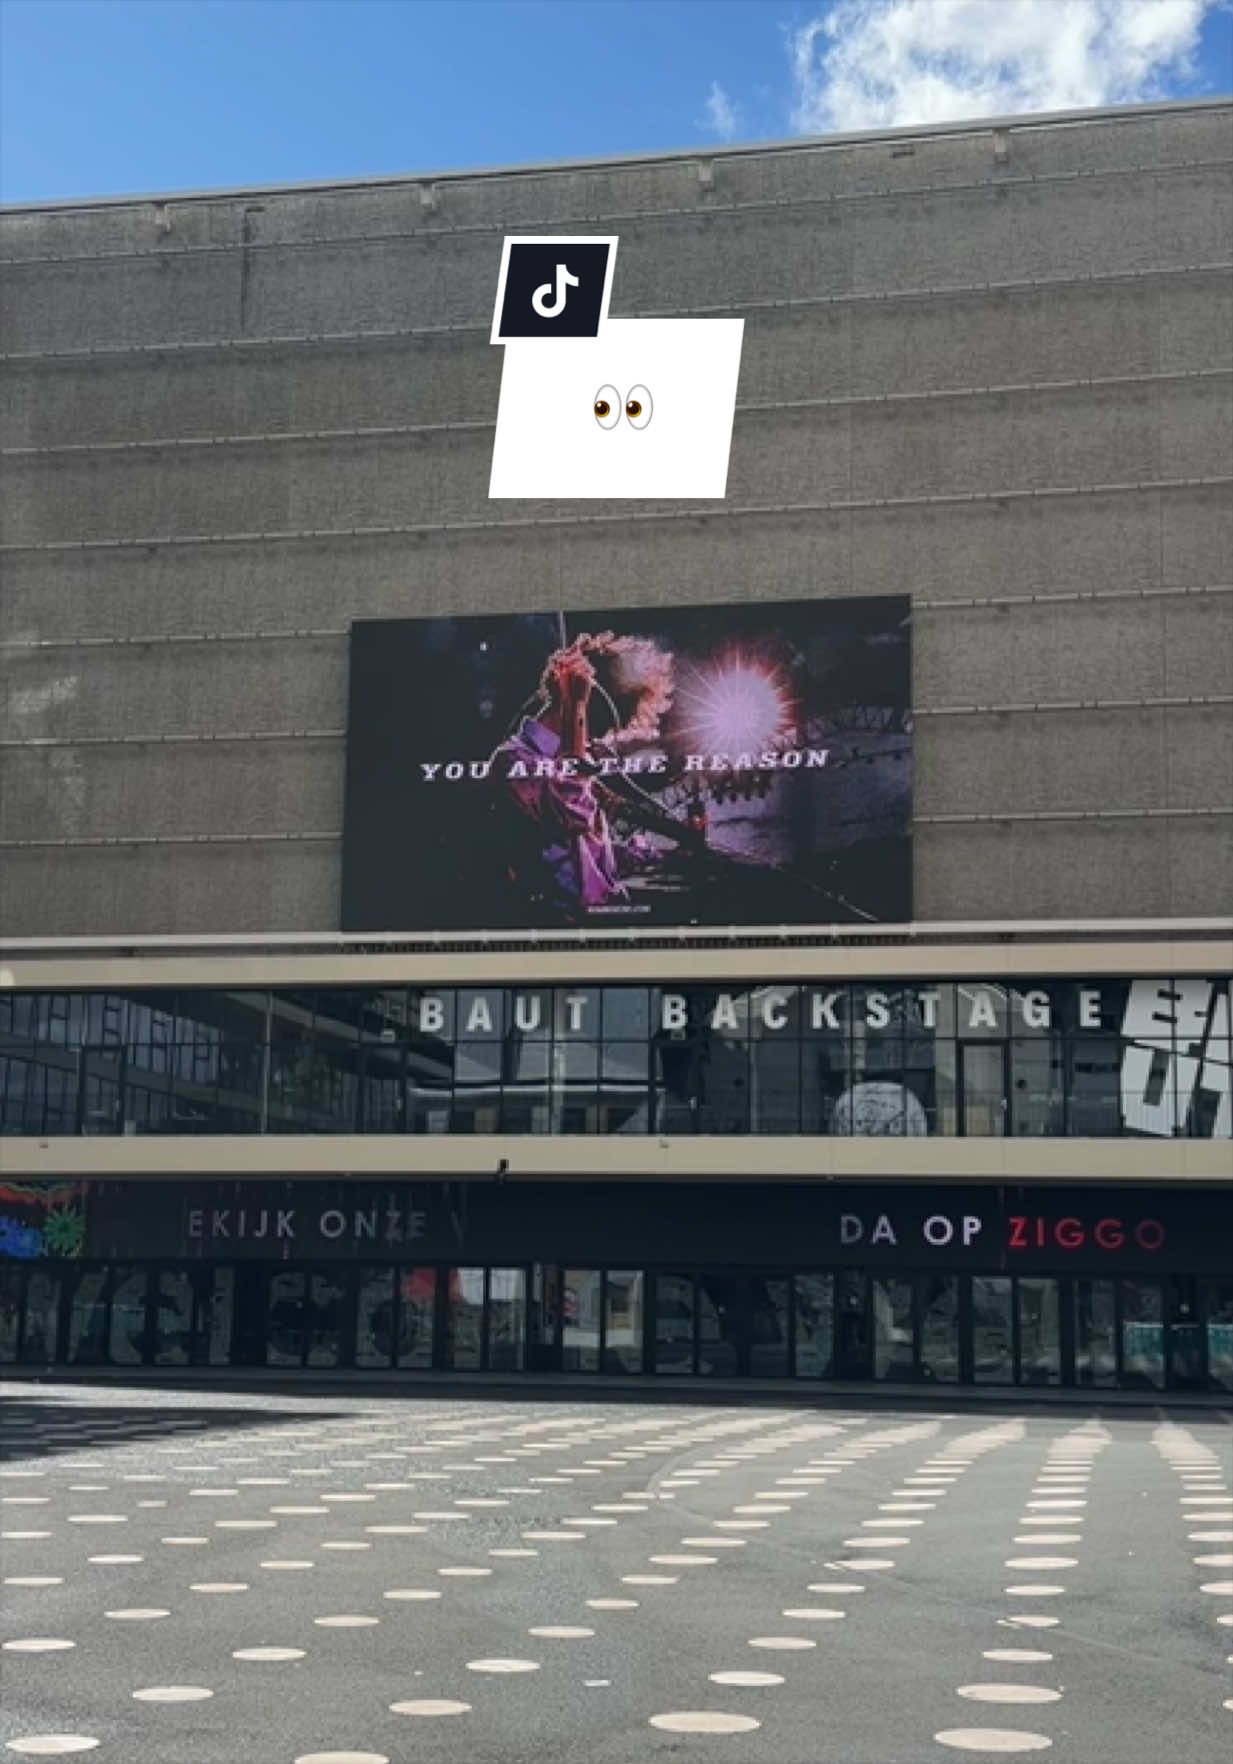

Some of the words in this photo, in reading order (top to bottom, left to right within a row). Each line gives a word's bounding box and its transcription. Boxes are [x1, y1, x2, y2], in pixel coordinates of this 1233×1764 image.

[420, 761, 491, 781] YOU
[506, 757, 579, 778] ARE
[599, 755, 669, 774] THE
[684, 750, 830, 771] REASON
[419, 996, 588, 1032] BAUT
[661, 990, 1102, 1030] BACKSTAGE
[319, 1209, 427, 1240] ONZE
[922, 1214, 983, 1246] OP
[1008, 1216, 1166, 1249] ZIGGO
